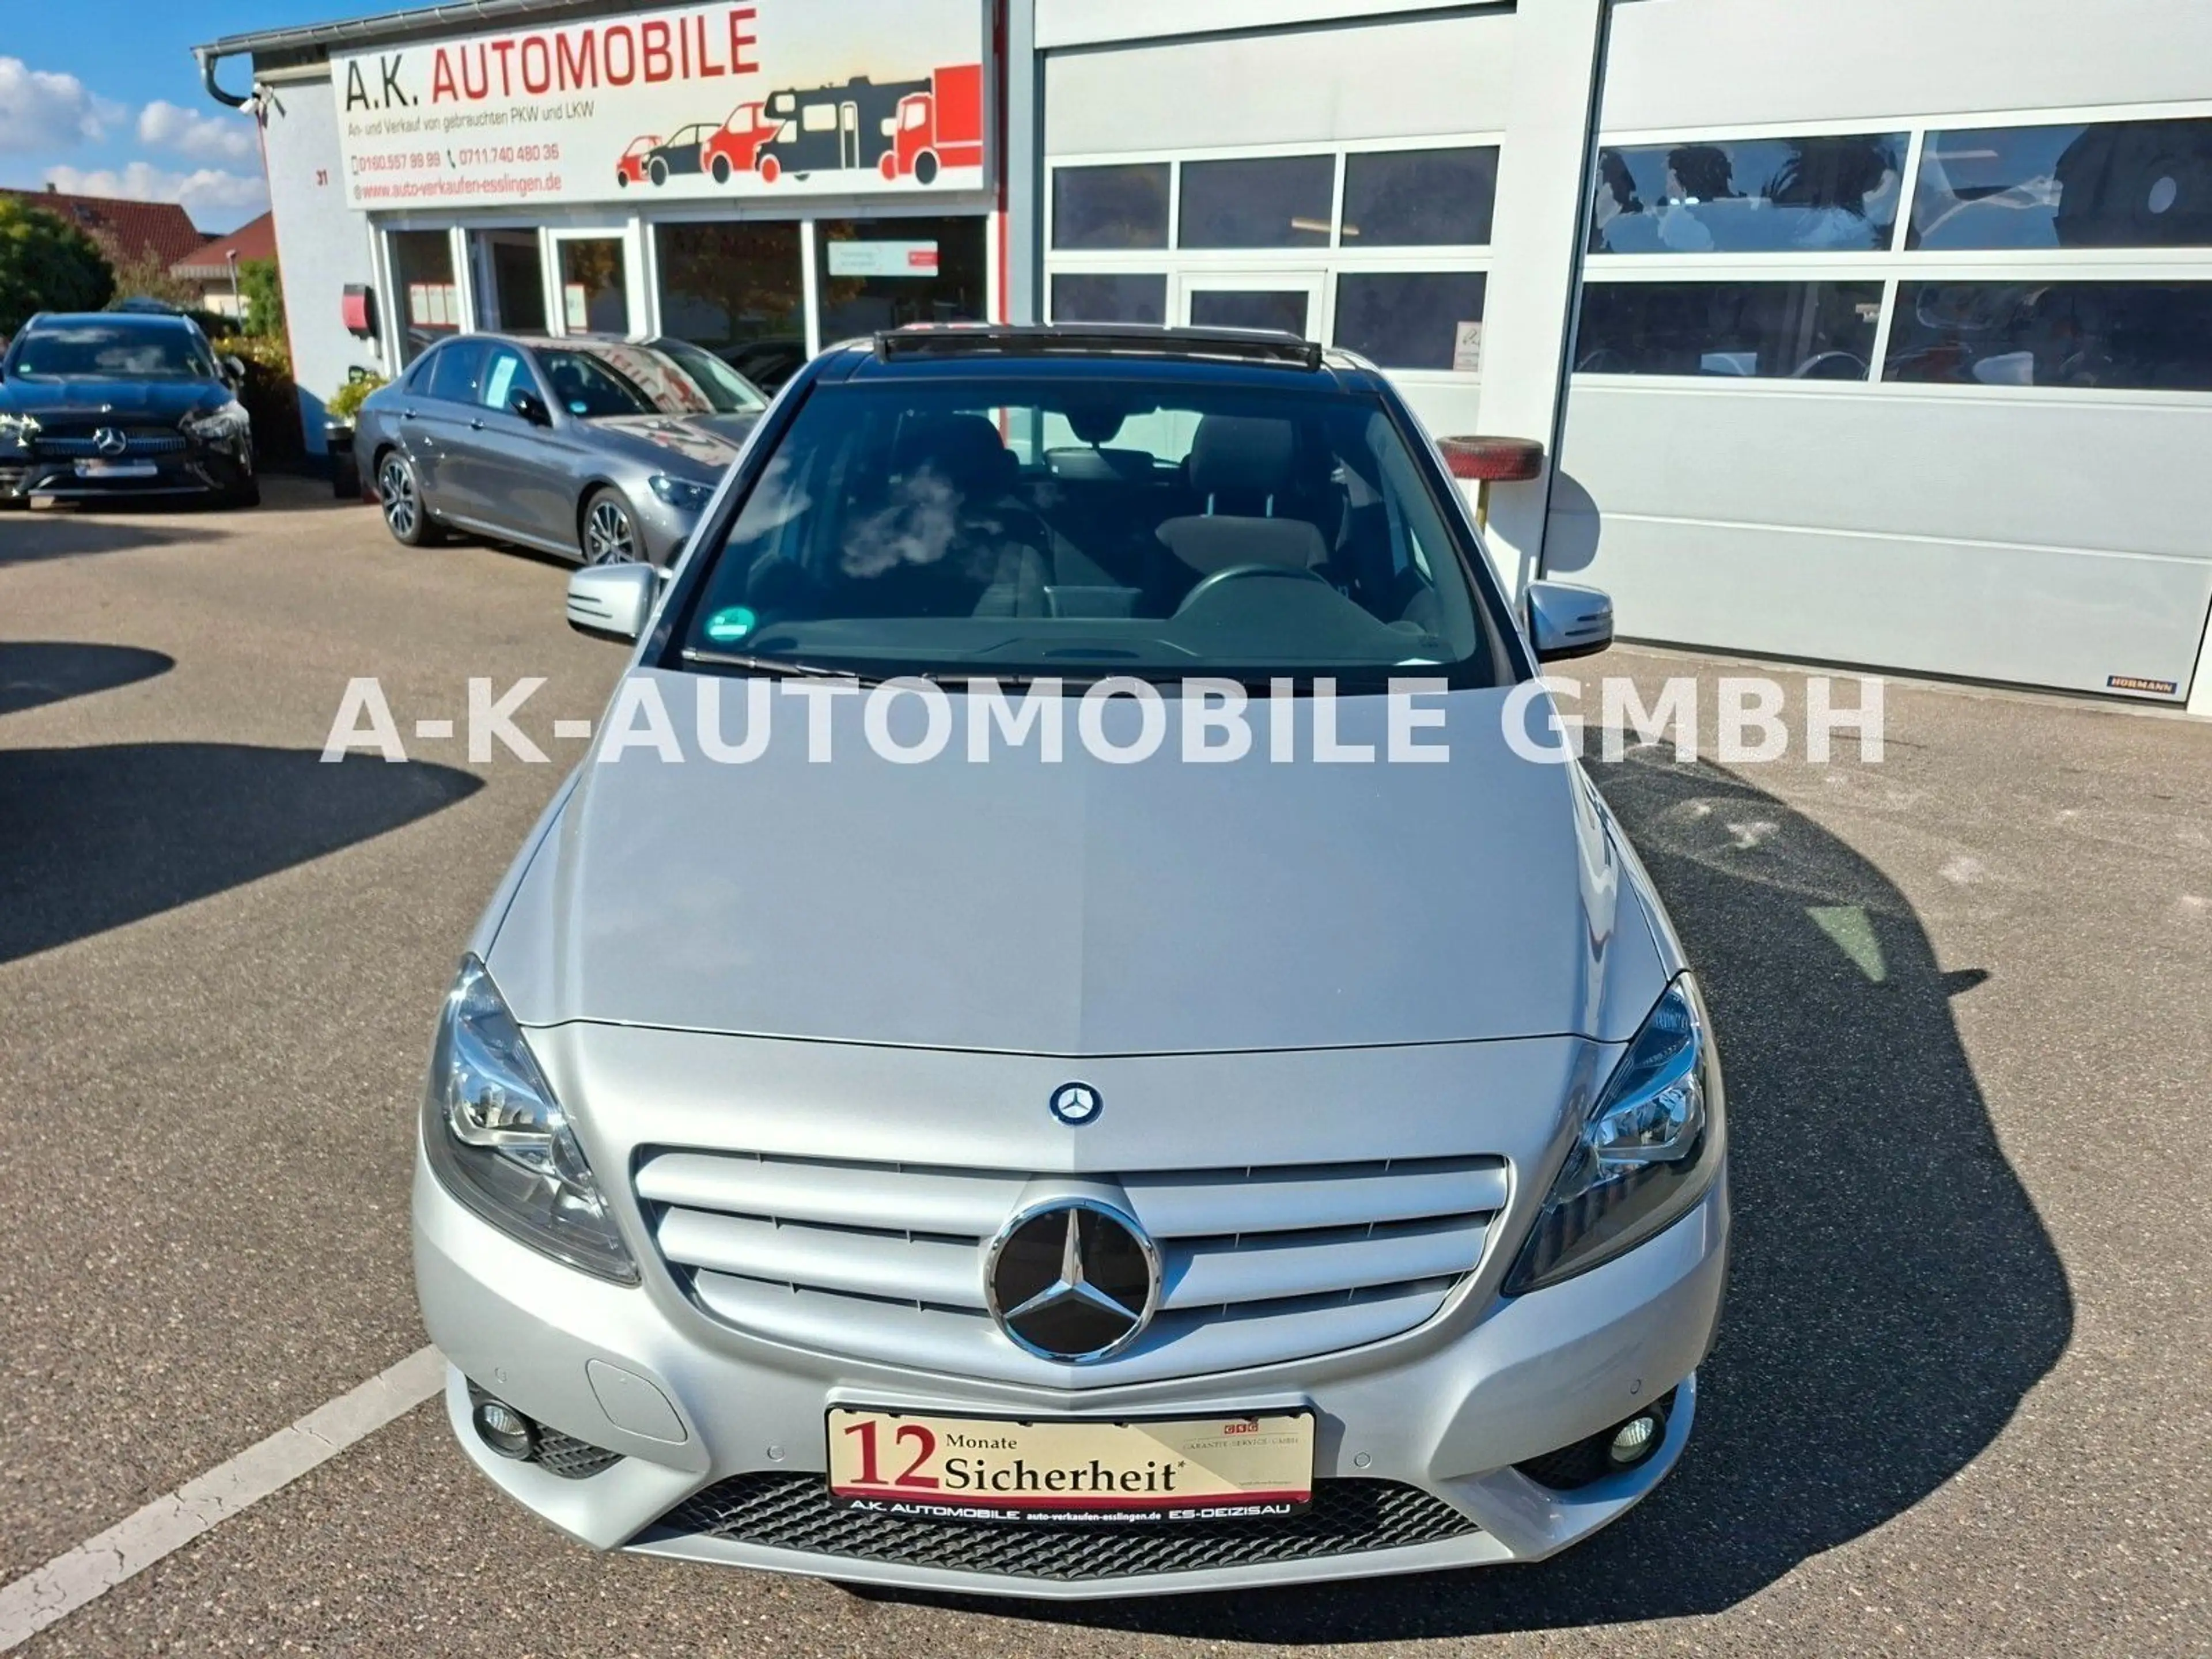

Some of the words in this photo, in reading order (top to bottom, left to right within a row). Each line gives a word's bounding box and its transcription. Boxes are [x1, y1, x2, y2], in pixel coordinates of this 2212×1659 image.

[347, 53, 418, 112] A.K.
[433, 7, 759, 104] AUTOMOBILE
[365, 120, 382, 135] und
[384, 116, 421, 134] Verkauf
[424, 117, 441, 131] von
[443, 111, 508, 133] gebrauchten
[510, 105, 539, 123] PKW
[543, 104, 563, 121] und
[566, 100, 594, 118] LKW
[363, 171, 562, 199] www.auto-verkaufen-esslingen.de
[844, 1420, 939, 1489] 12
[946, 1433, 1018, 1450] Monate
[890, 1503, 1020, 1520] AUTOMOBILE
[1026, 1511, 1162, 1521] auto-verkaufen-esslingen.de
[1168, 1503, 1291, 1520] ES-DEIZISAU
